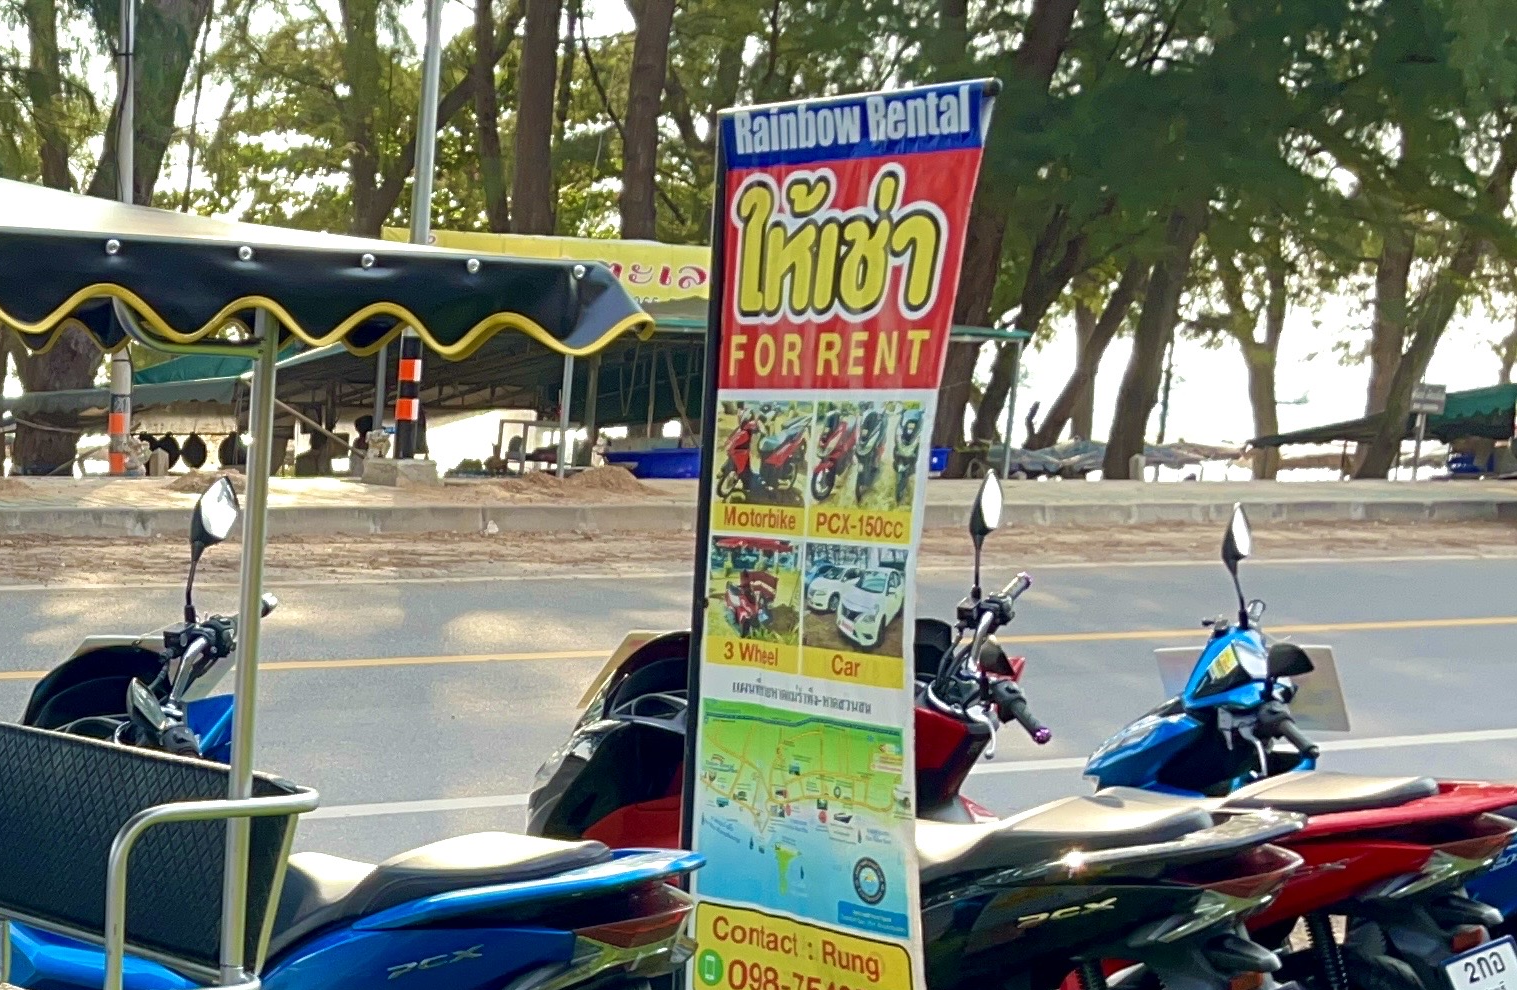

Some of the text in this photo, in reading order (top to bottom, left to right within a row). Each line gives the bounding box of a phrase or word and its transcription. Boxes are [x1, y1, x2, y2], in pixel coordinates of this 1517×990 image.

[734, 85, 970, 155] Rainbow Rental
[736, 168, 942, 318] ให้เช่า
[729, 329, 931, 376] FOR RENT
[723, 506, 796, 531] Motorbike
[816, 512, 904, 539] PCX-150cc
[723, 641, 779, 667] 3 Wheel
[831, 654, 861, 678] Car
[1017, 897, 1117, 928] PCX
[387, 944, 484, 980] PCX
[712, 915, 799, 957] Contact
[821, 939, 880, 984] Rung
